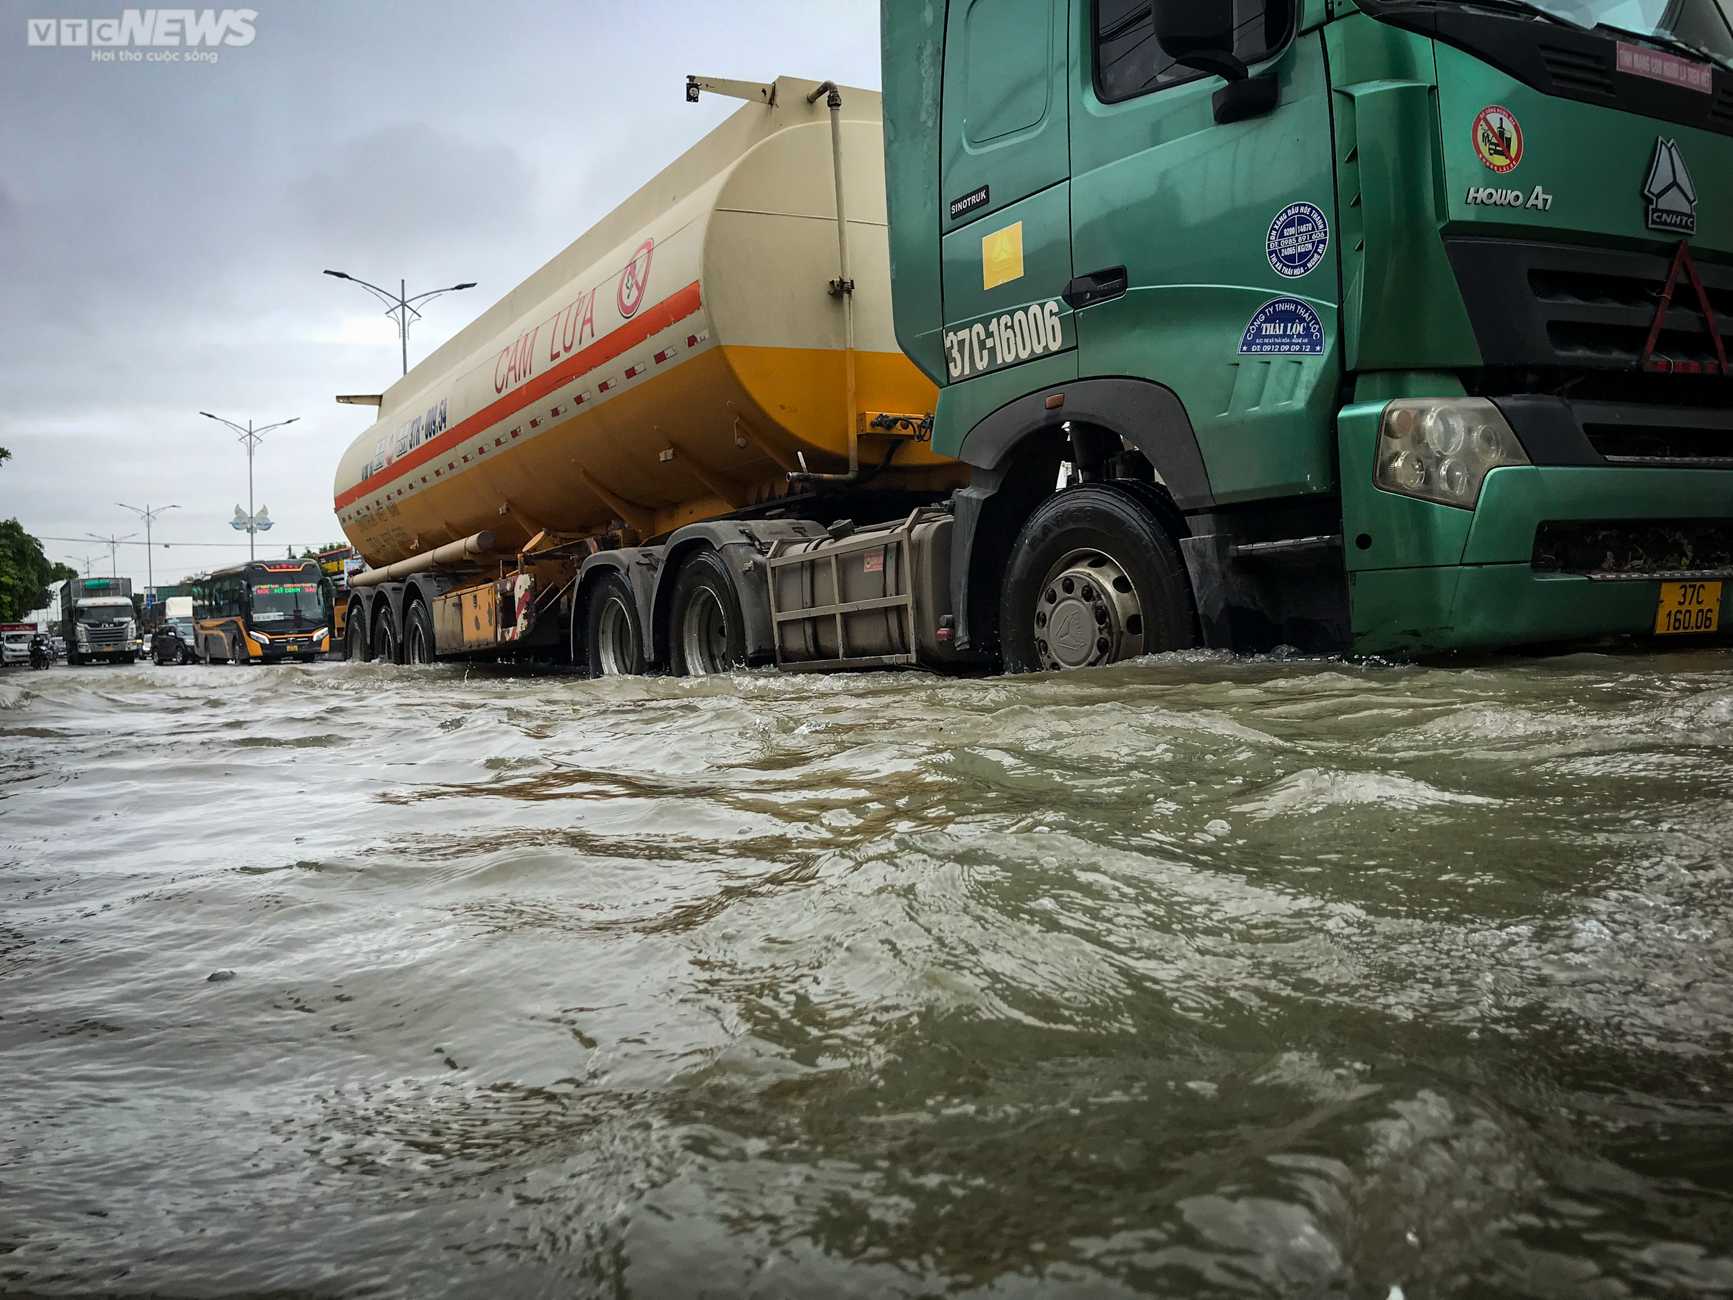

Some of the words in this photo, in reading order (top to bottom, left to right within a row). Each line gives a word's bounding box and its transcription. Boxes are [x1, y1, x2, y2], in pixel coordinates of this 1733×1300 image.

[951, 190, 987, 215] SINOTRUK
[1467, 187, 1523, 207] HOWO
[1526, 186, 1553, 210] A7
[1652, 211, 1695, 227] CNHTC
[1246, 313, 1265, 340] CÔNG
[1265, 305, 1274, 316] TY
[1275, 302, 1296, 312] TNHH
[1296, 305, 1312, 322] THÁI
[1260, 320, 1284, 335] THÁI
[1286, 319, 1307, 339] LỘC
[946, 300, 1063, 378] 37C-16006
[1678, 584, 1705, 606] 37C
[1666, 608, 1713, 631] 160.06
